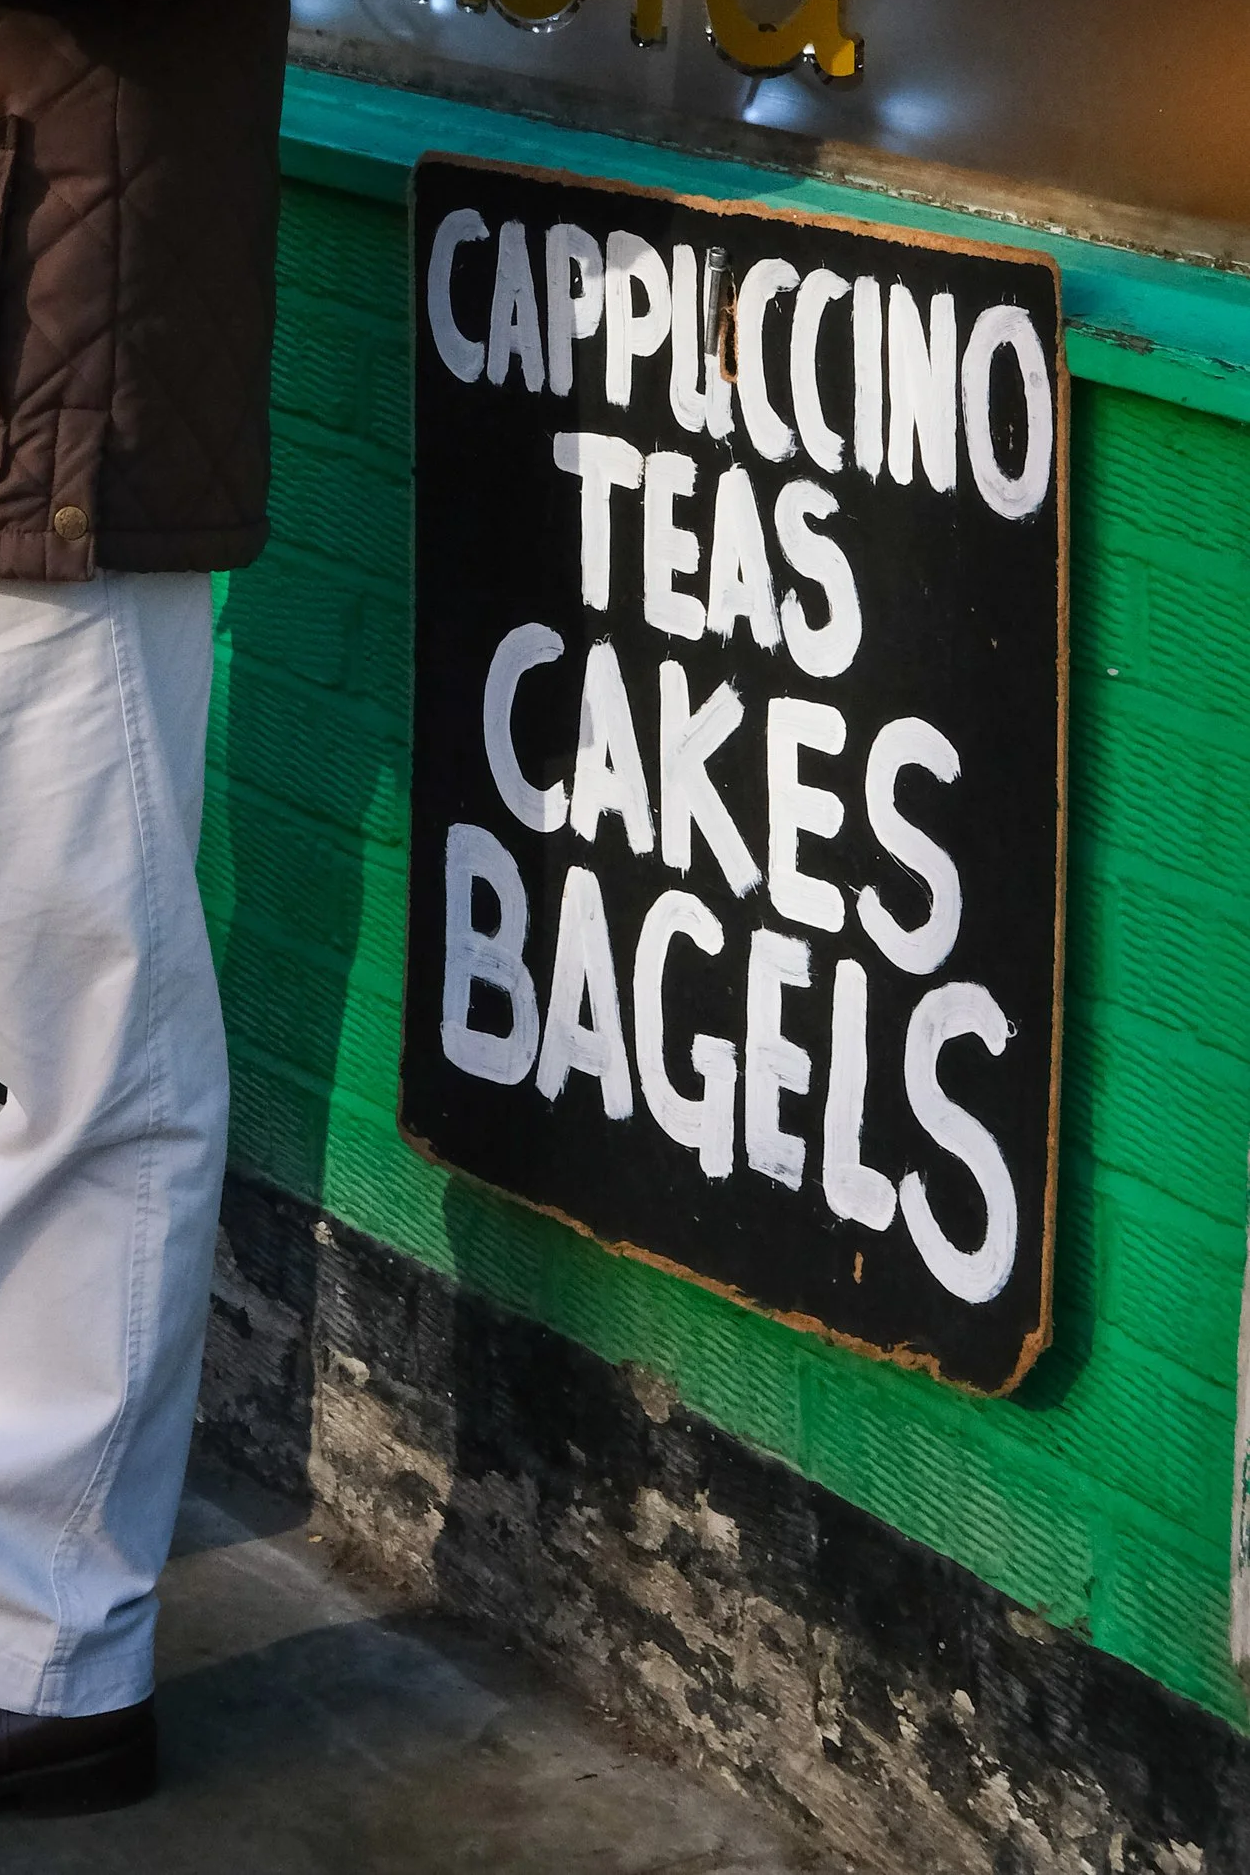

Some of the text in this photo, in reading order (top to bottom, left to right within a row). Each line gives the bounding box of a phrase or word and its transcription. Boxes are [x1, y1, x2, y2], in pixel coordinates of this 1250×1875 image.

[427, 208, 1053, 521] CAPPUCCINO
[553, 431, 863, 679] TEAS
[483, 622, 962, 975] CAKES
[441, 823, 1018, 1305] BAGELS
